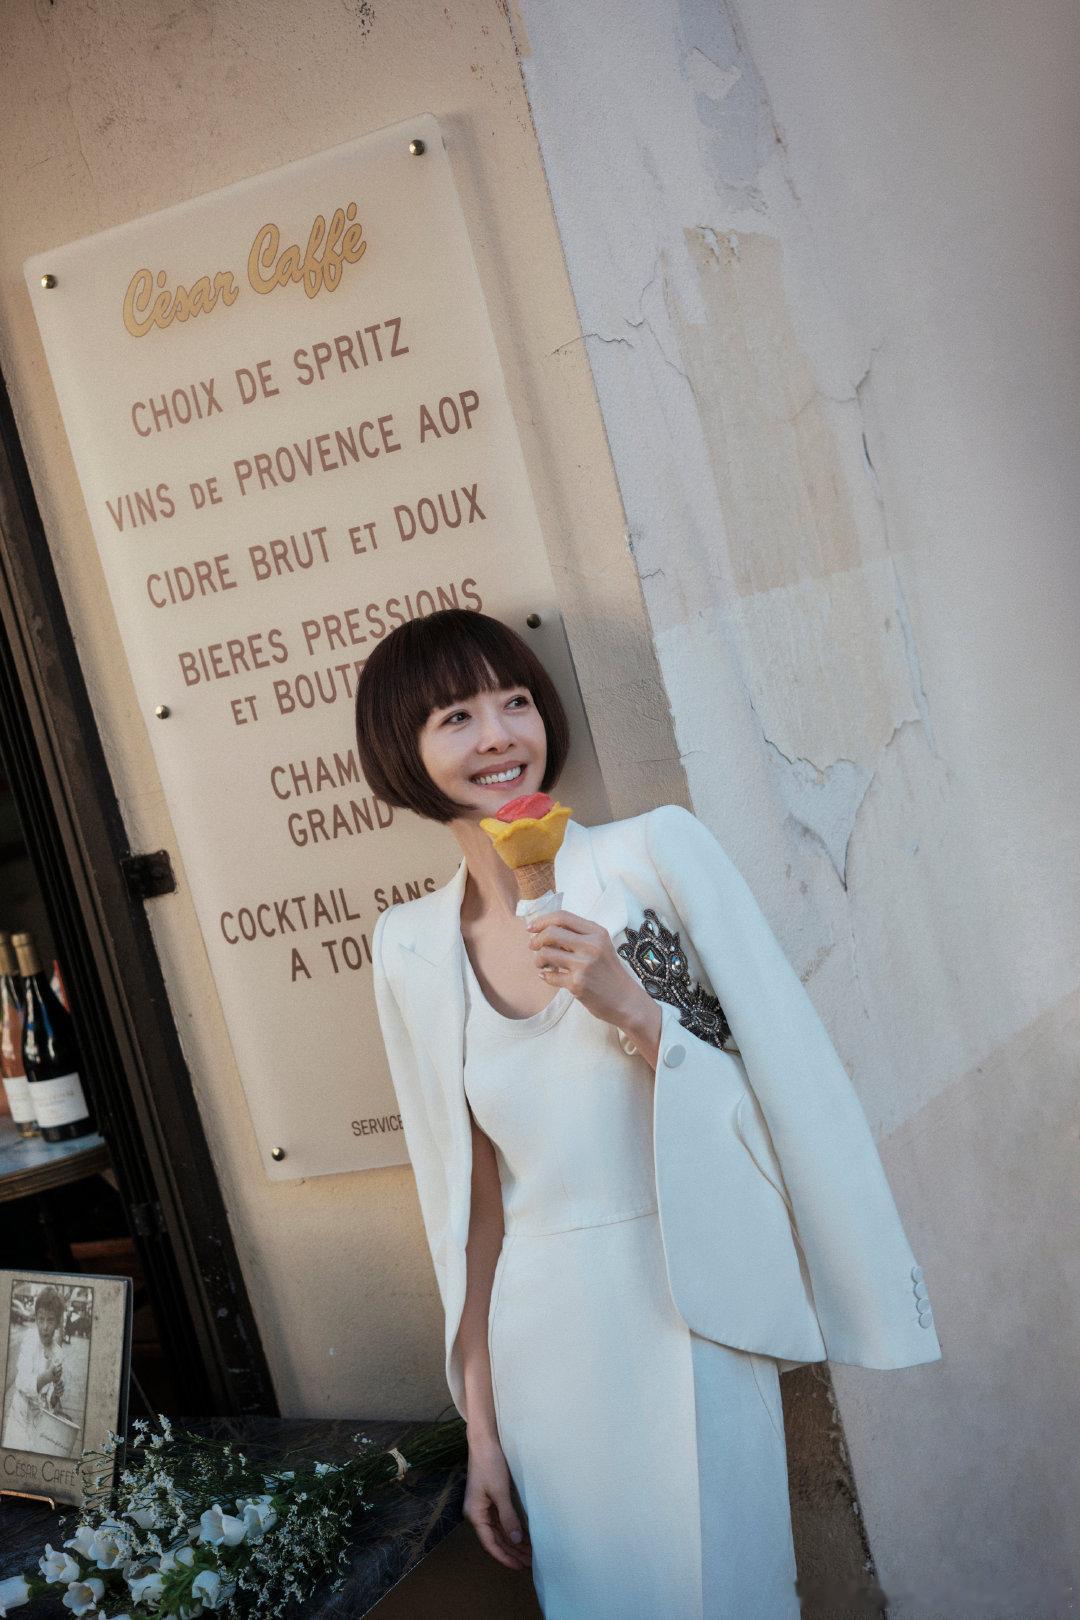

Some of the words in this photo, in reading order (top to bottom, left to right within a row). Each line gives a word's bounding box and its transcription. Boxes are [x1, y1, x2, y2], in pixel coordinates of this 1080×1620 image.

[123, 268, 239, 337] César
[247, 202, 367, 299] Caffé
[131, 378, 223, 437] CHOIX
[235, 359, 280, 405] DE
[293, 316, 410, 386] SPRITZ
[105, 483, 175, 533] VINS
[189, 476, 223, 510] DE
[233, 414, 402, 496] PROVENCE
[420, 389, 480, 443] AOP
[146, 553, 238, 608] CIDRE
[248, 526, 330, 581] BRUT
[348, 521, 379, 555] ET
[393, 483, 487, 542] DOUX
[178, 628, 289, 687] BIERES
[301, 577, 483, 656] PRESSIONS
[230, 695, 259, 725] ET
[270, 749, 360, 800] CHAM
[287, 795, 394, 847] GRAND
[220, 887, 361, 944] COCKTAIL
[374, 877, 437, 913] SANS
[291, 947, 312, 982] A
